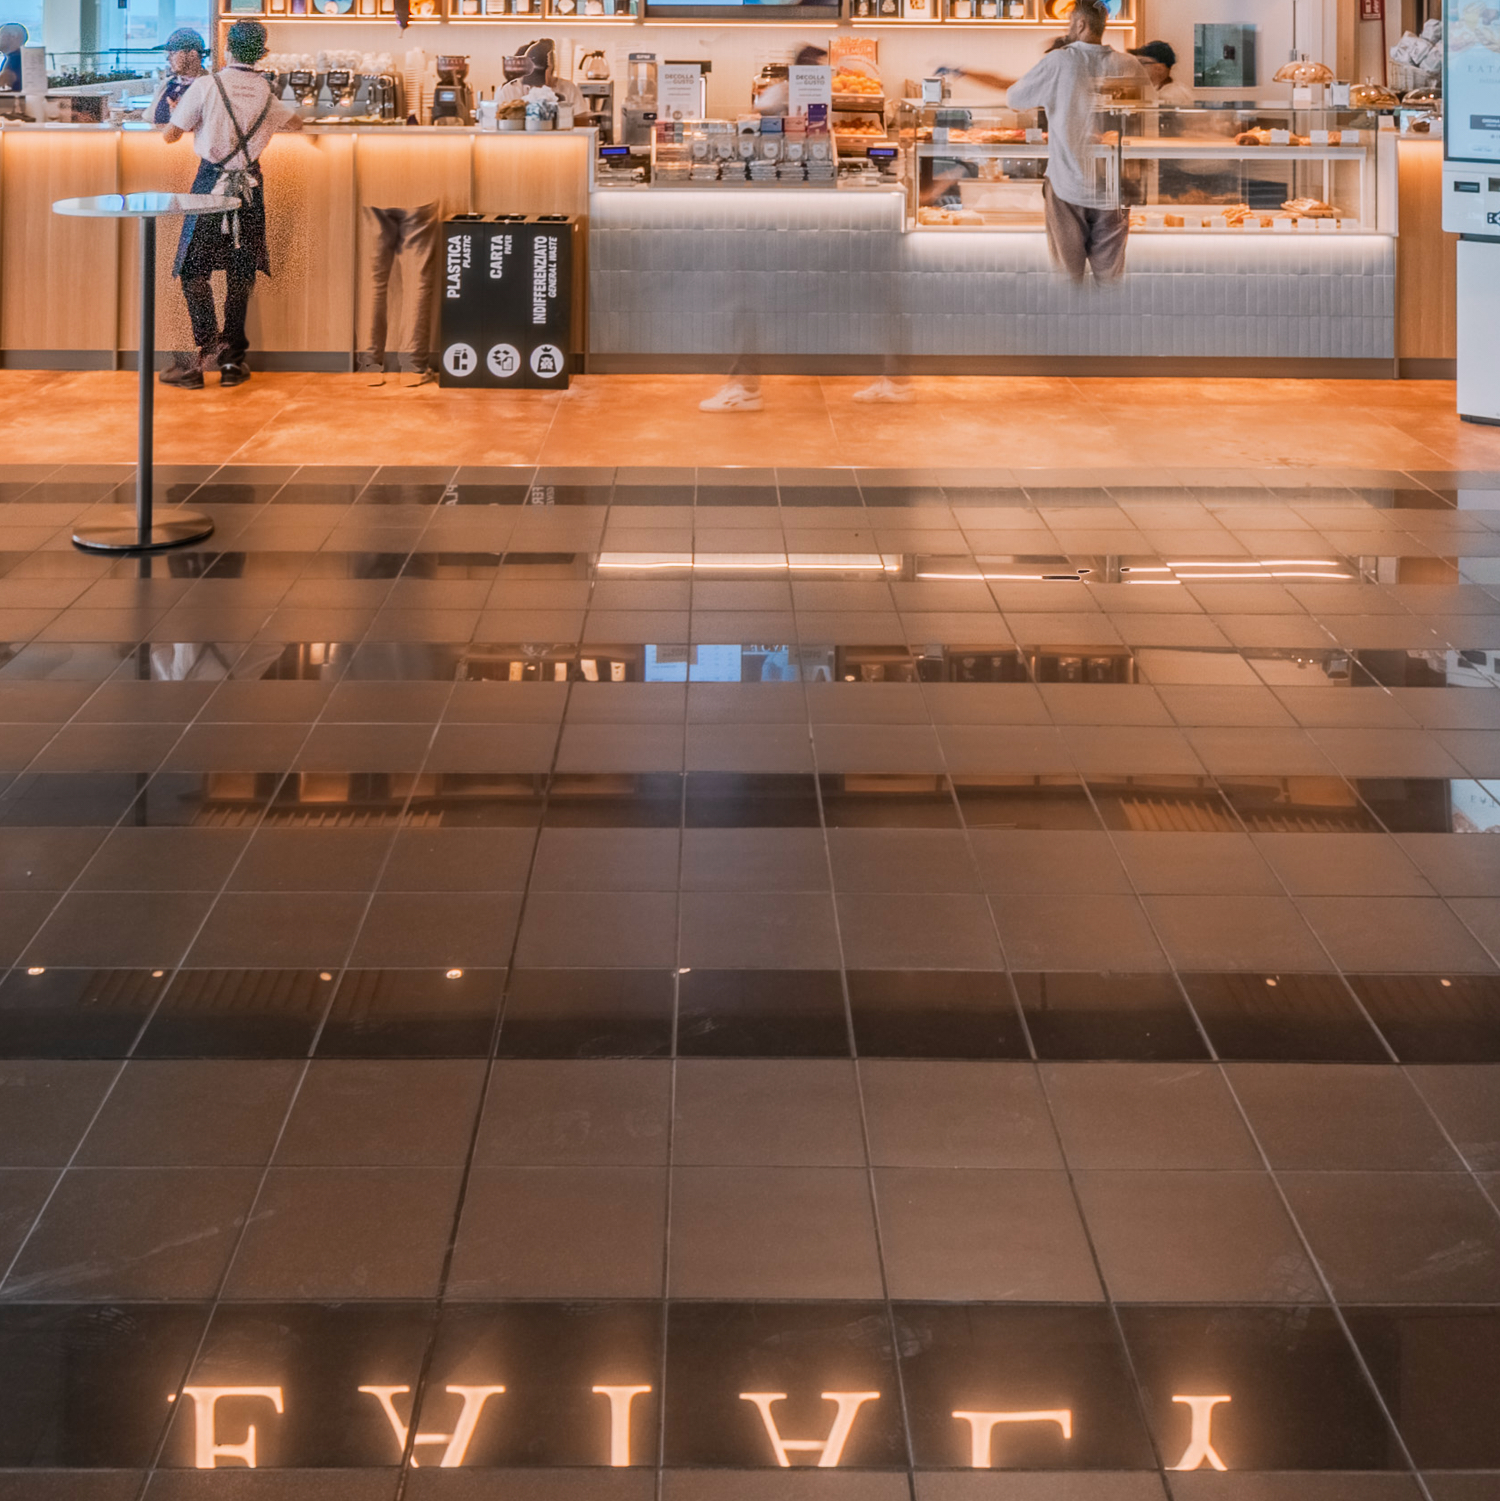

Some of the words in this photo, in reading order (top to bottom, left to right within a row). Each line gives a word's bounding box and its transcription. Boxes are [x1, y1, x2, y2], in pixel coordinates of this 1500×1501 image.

[447, 235, 461, 298] PLASTICA
[463, 235, 472, 268] PLASTIC
[490, 235, 504, 279] CARTA
[533, 236, 548, 324] INDIFFERENZIATO
